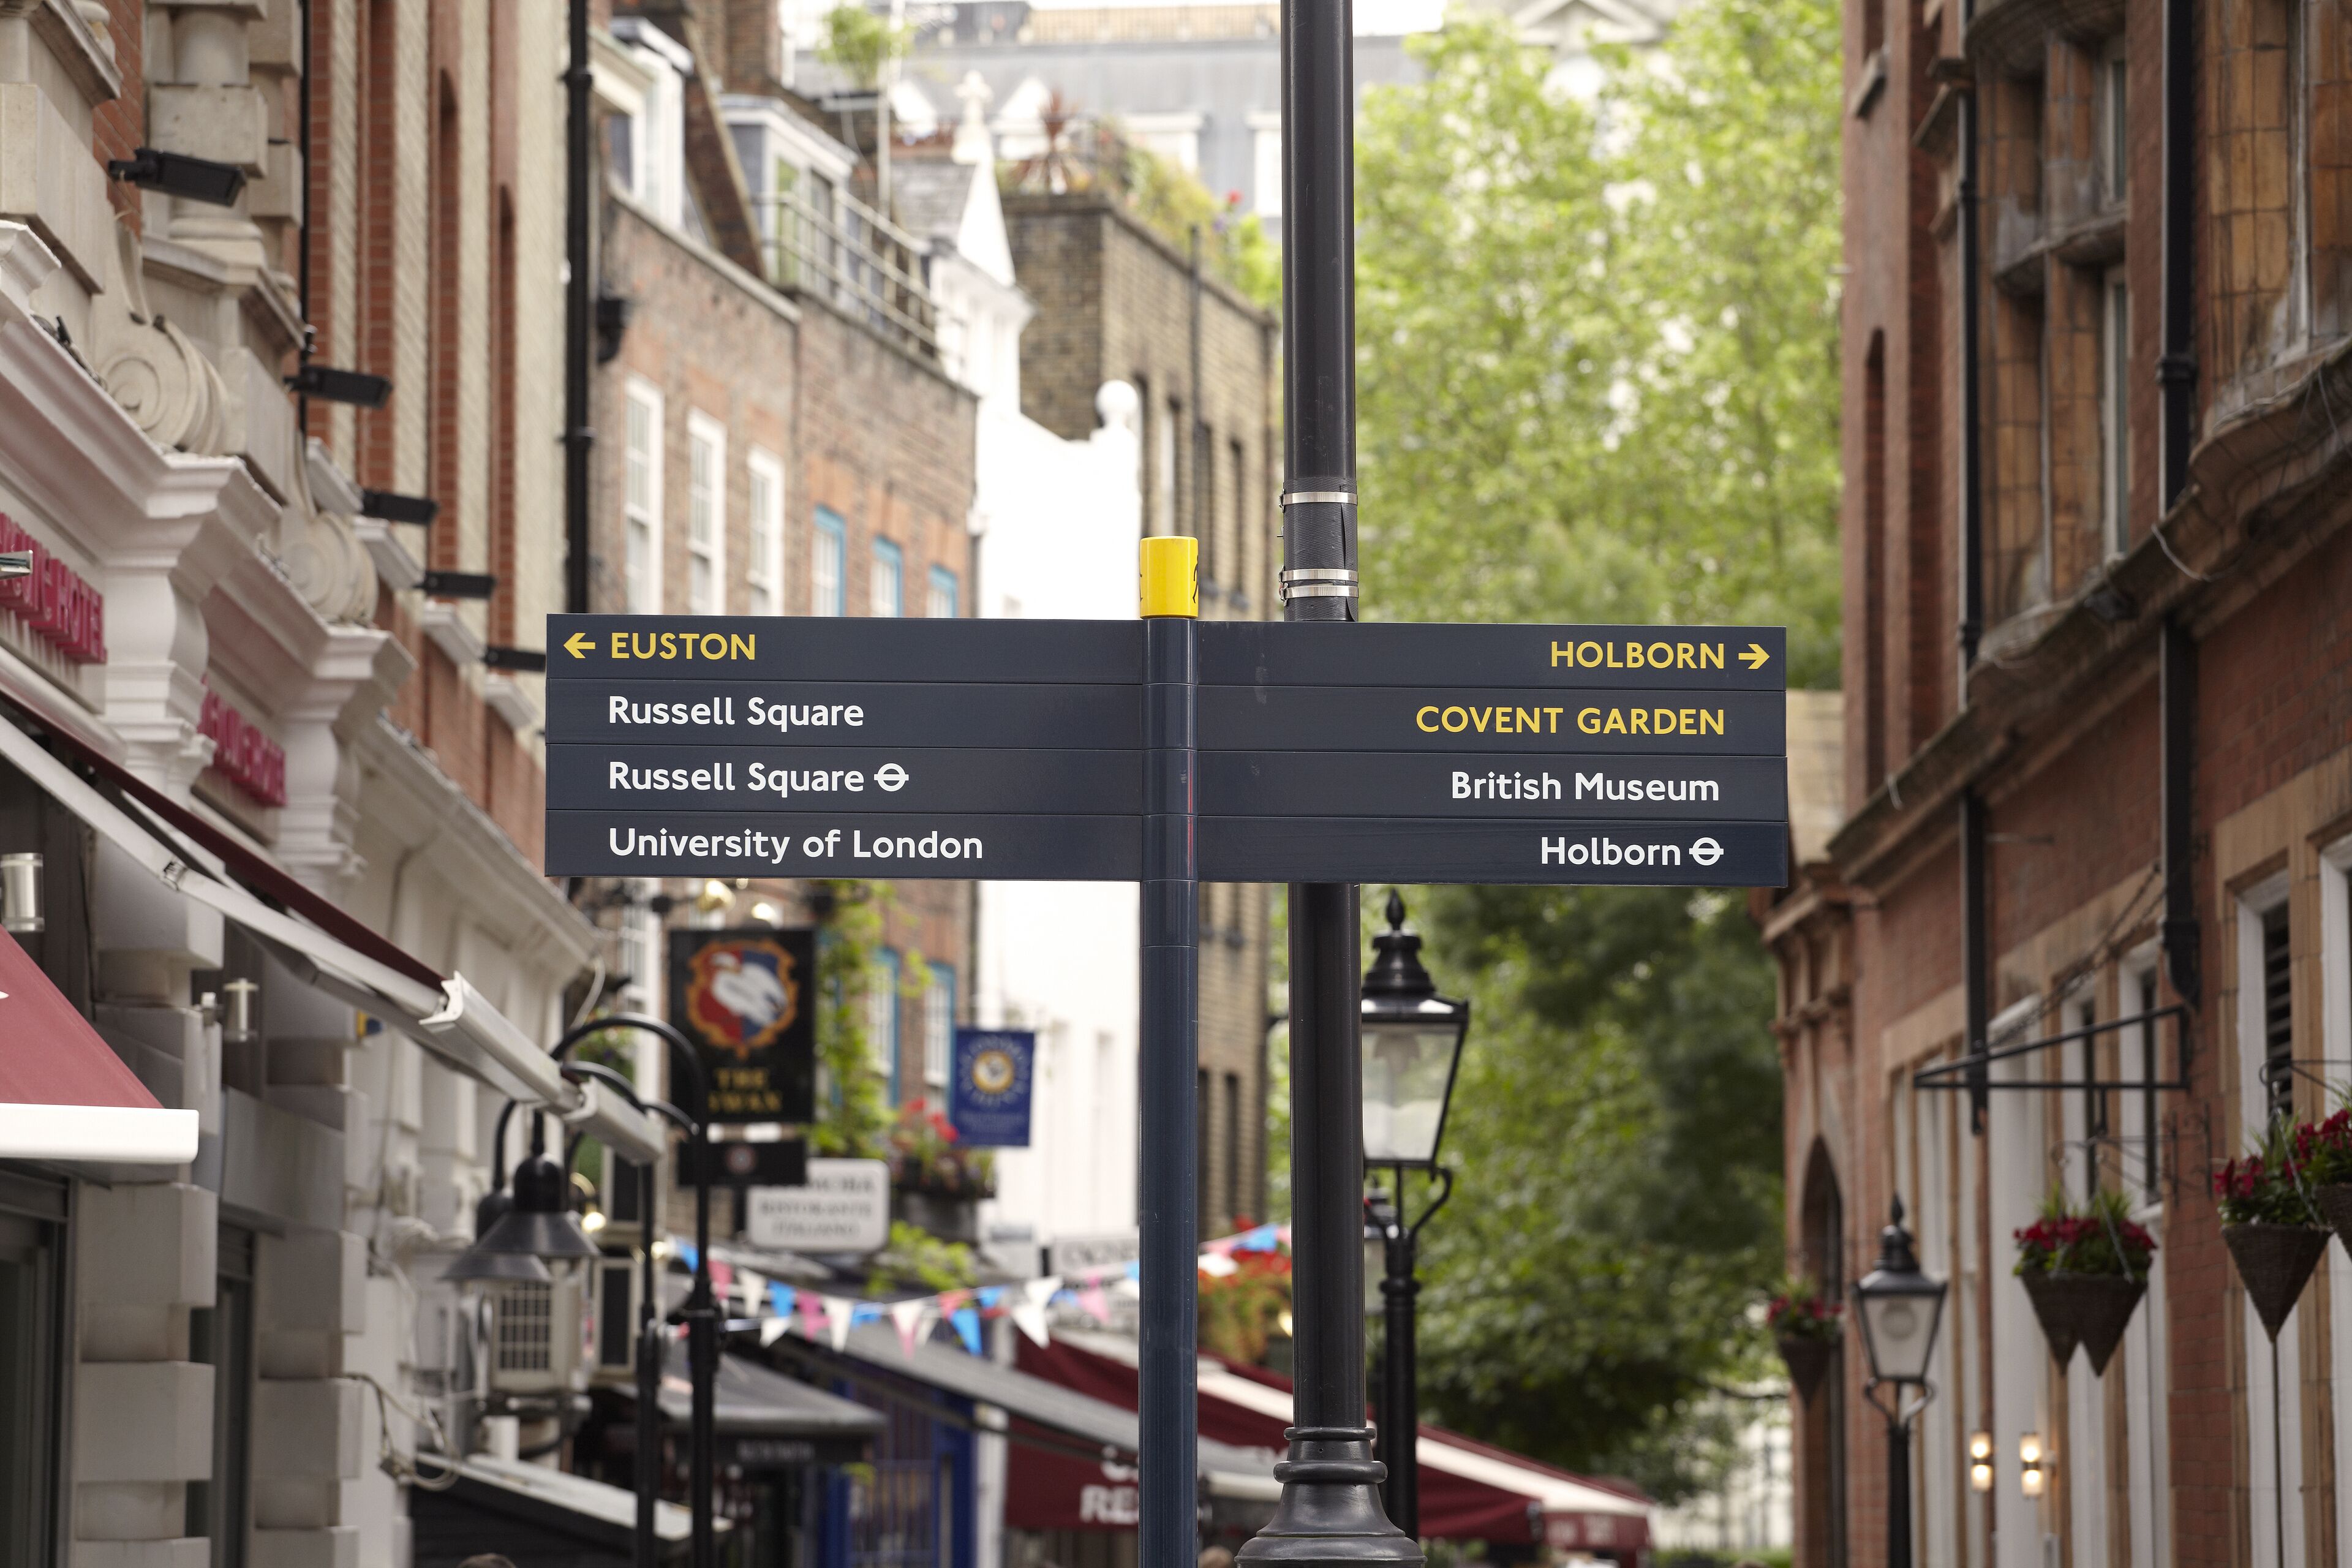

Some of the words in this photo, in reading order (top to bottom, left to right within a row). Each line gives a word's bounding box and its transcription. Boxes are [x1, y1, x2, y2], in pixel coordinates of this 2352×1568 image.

[611, 632, 755, 660] EUSTON
[1551, 641, 1724, 669] HOLBORN
[609, 696, 735, 725] Russell
[747, 696, 864, 733] Square
[1416, 706, 1564, 733] COVENT
[1577, 707, 1724, 735] GARDEN
[609, 761, 736, 791] Russell
[747, 762, 864, 798] Square
[1452, 771, 1561, 800] British
[1575, 772, 1719, 801] Museum
[609, 827, 791, 864] University
[802, 829, 841, 858] of
[853, 830, 982, 859] London
[1541, 837, 1681, 865] Holborn
